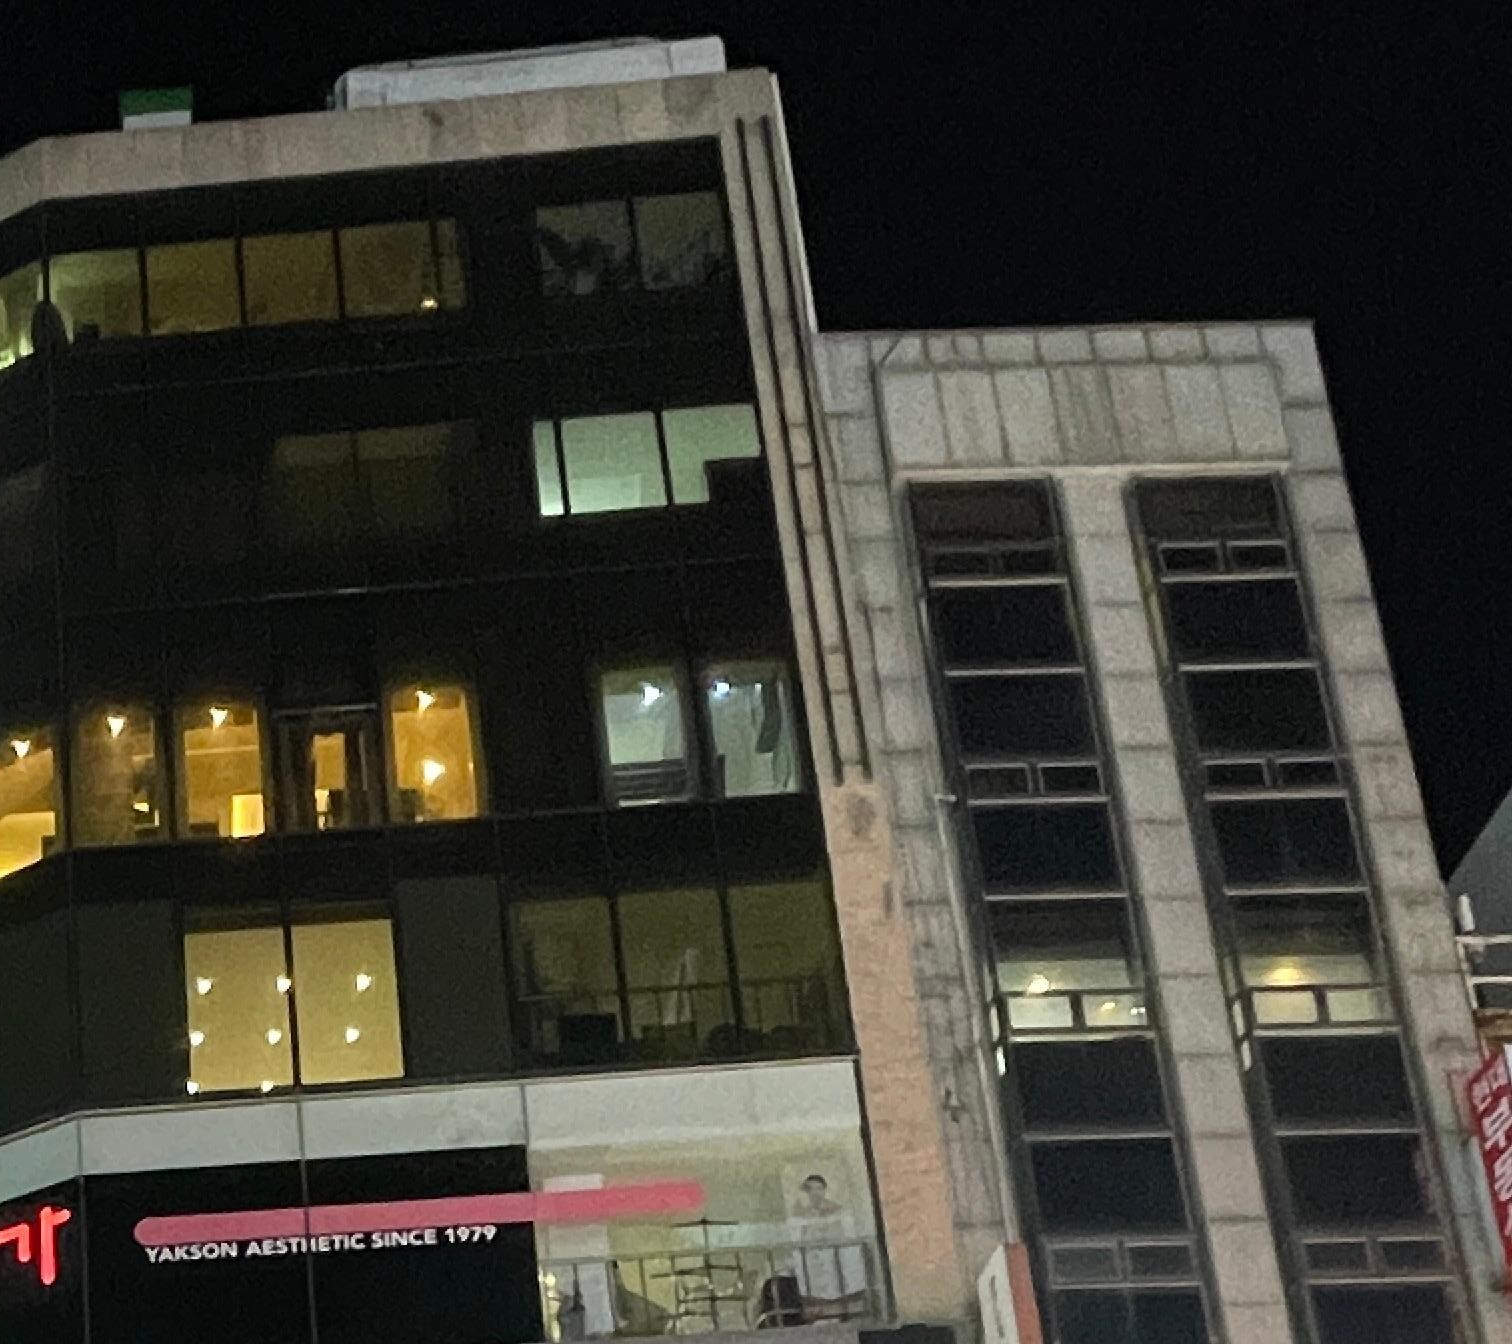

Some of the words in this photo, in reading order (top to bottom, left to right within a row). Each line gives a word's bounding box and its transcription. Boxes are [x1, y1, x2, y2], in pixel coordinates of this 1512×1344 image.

[144, 1241, 239, 1264] YAKSON
[245, 1230, 367, 1258] AESTHETIC
[371, 1228, 438, 1250] SINCE
[443, 1224, 499, 1245] 1979
